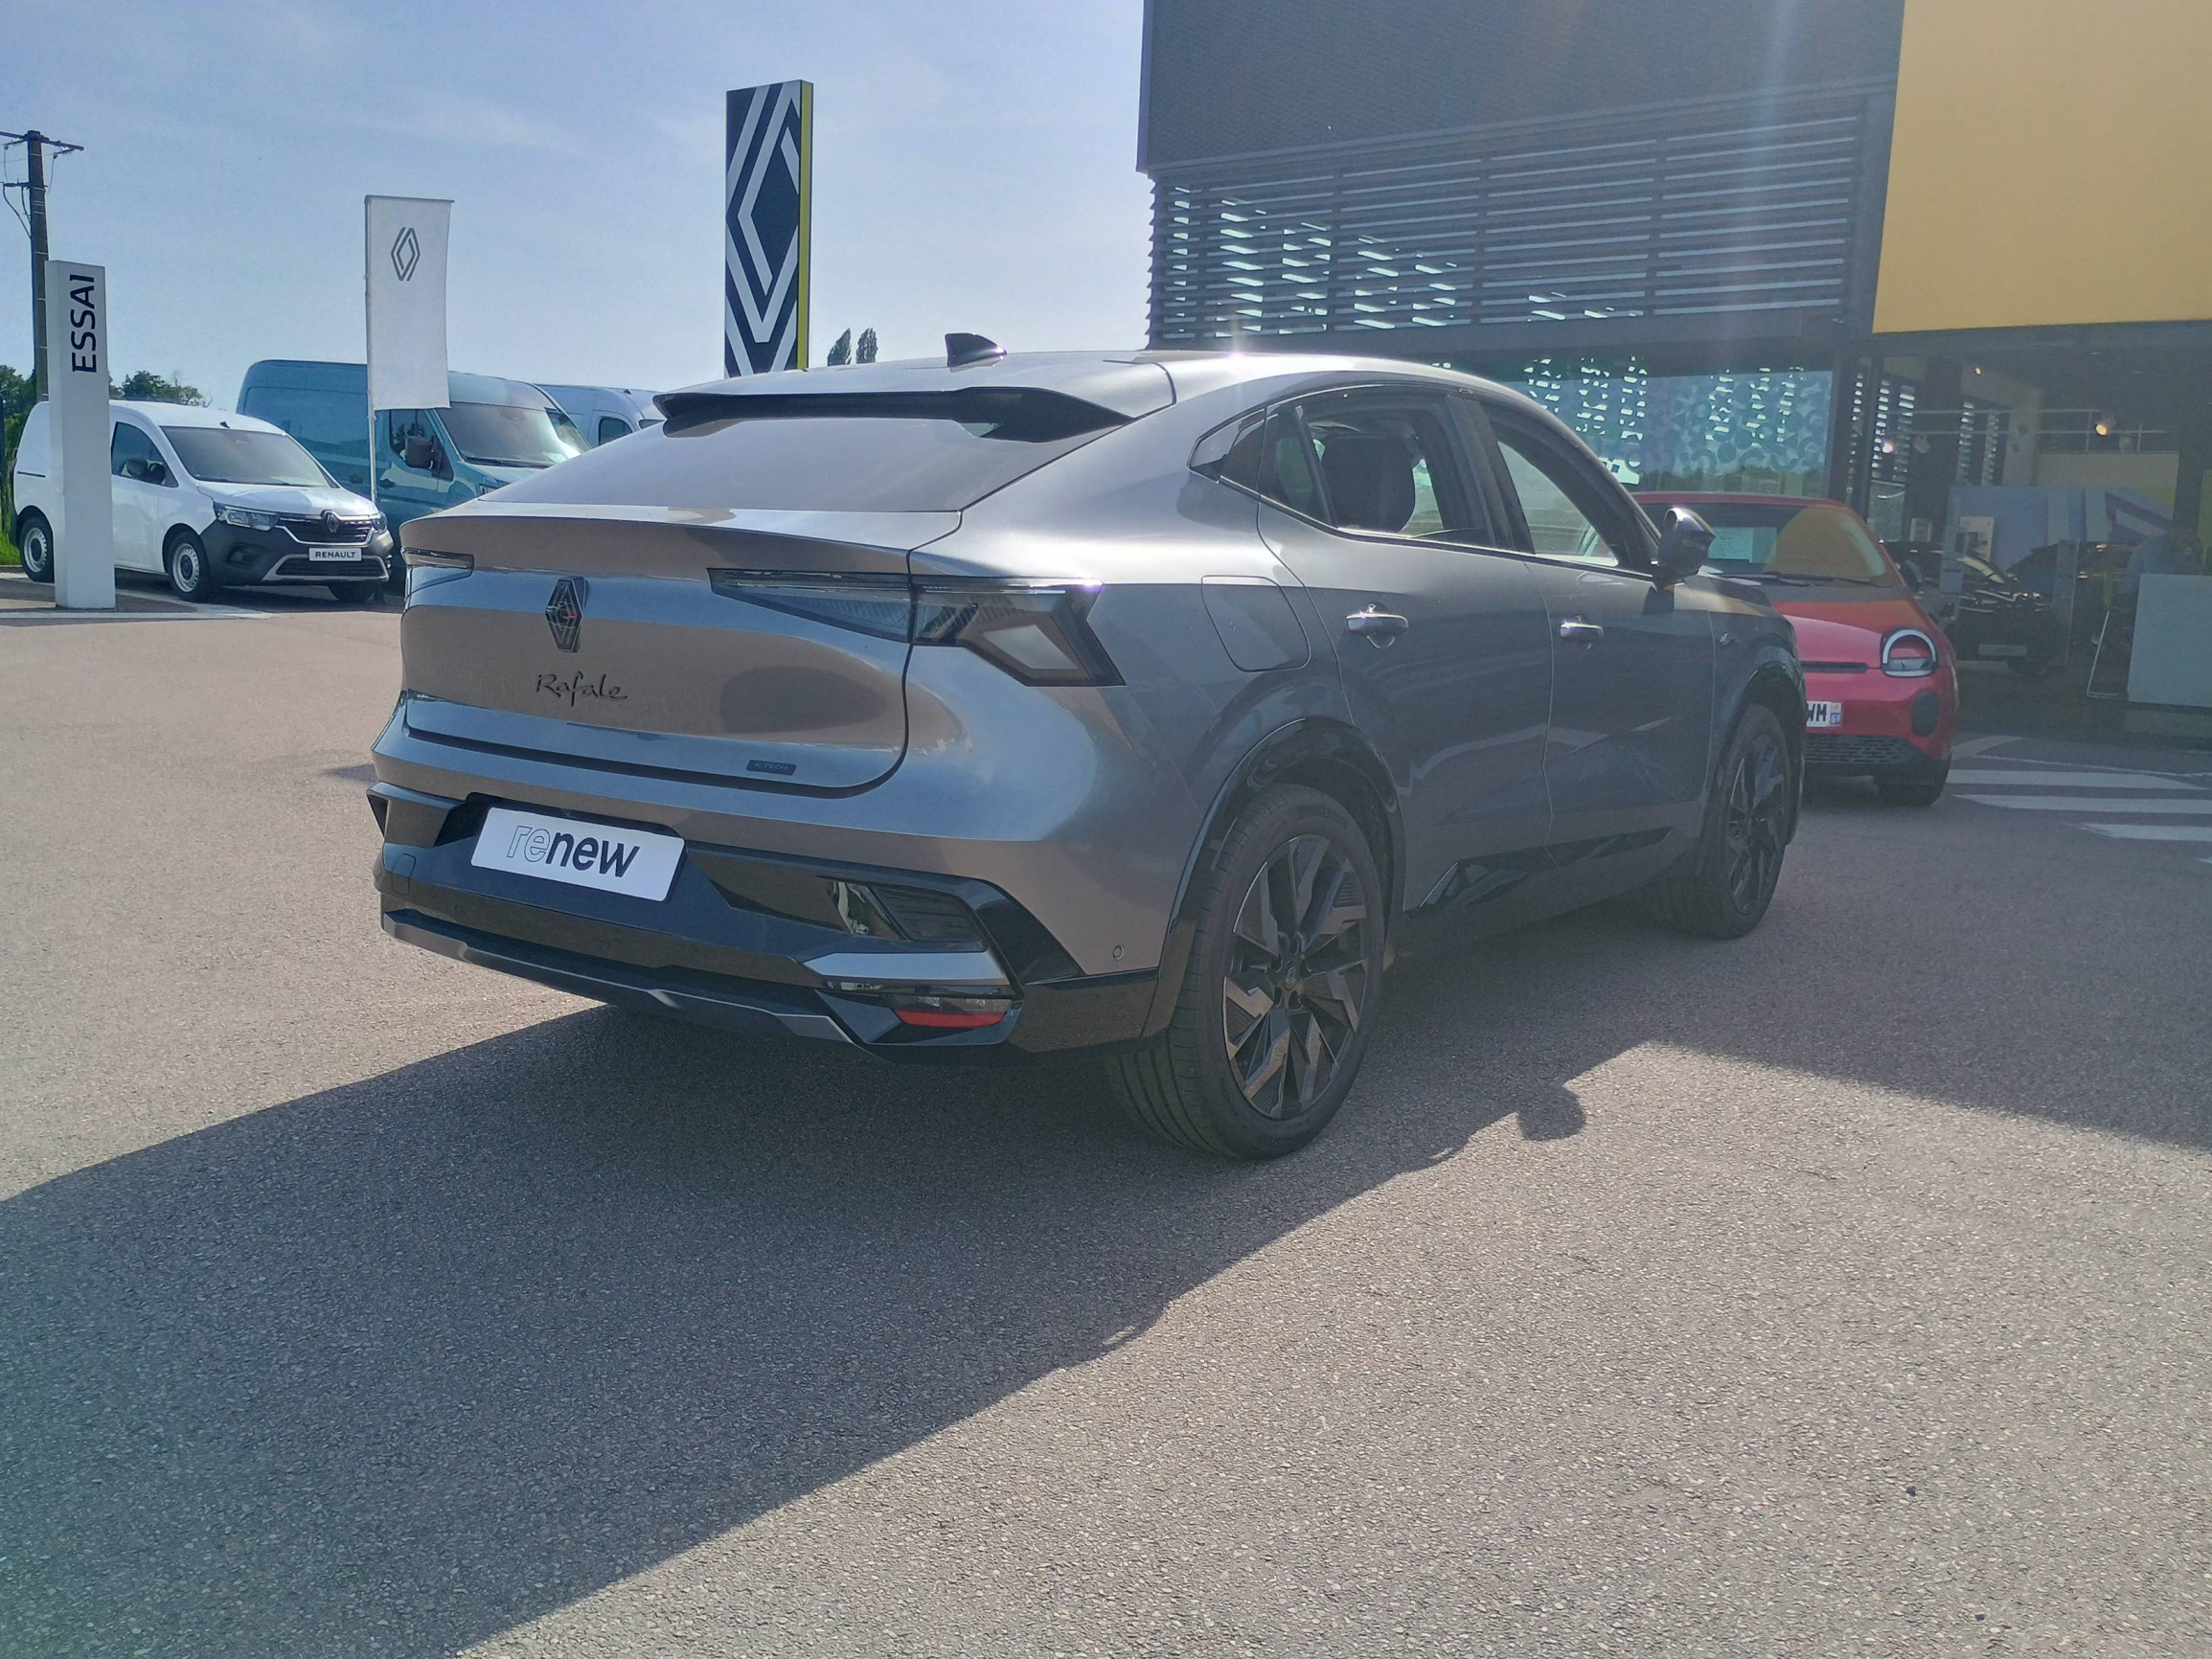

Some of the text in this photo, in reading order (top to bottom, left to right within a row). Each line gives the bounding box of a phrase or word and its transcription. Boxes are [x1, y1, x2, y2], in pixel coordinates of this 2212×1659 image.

[69, 274, 97, 373] ESSAI
[536, 670, 627, 707] Rafale
[506, 825, 640, 878] renew
